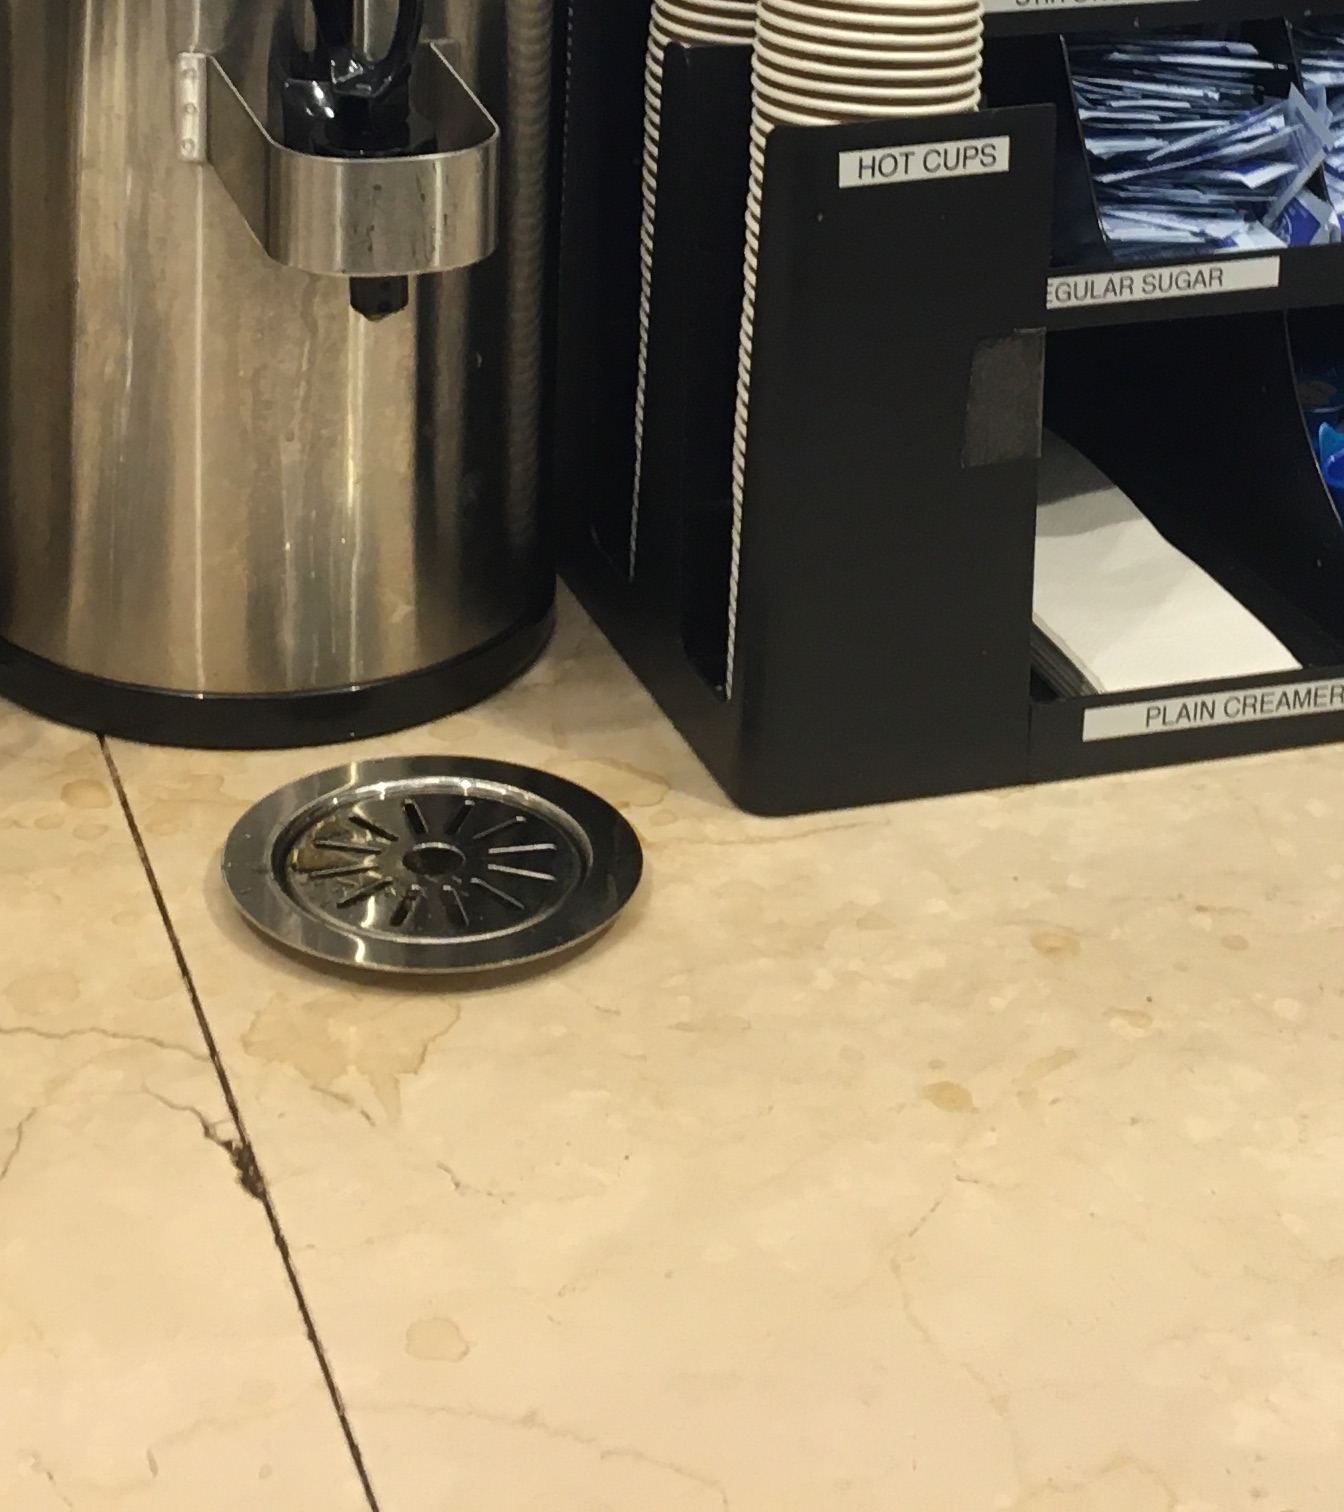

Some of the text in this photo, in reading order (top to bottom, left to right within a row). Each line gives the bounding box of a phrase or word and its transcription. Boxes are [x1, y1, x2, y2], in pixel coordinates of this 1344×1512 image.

[858, 143, 997, 180] HOT CUPS
[1141, 267, 1224, 295] SUGAR
[1145, 699, 1216, 728] PLAIN
